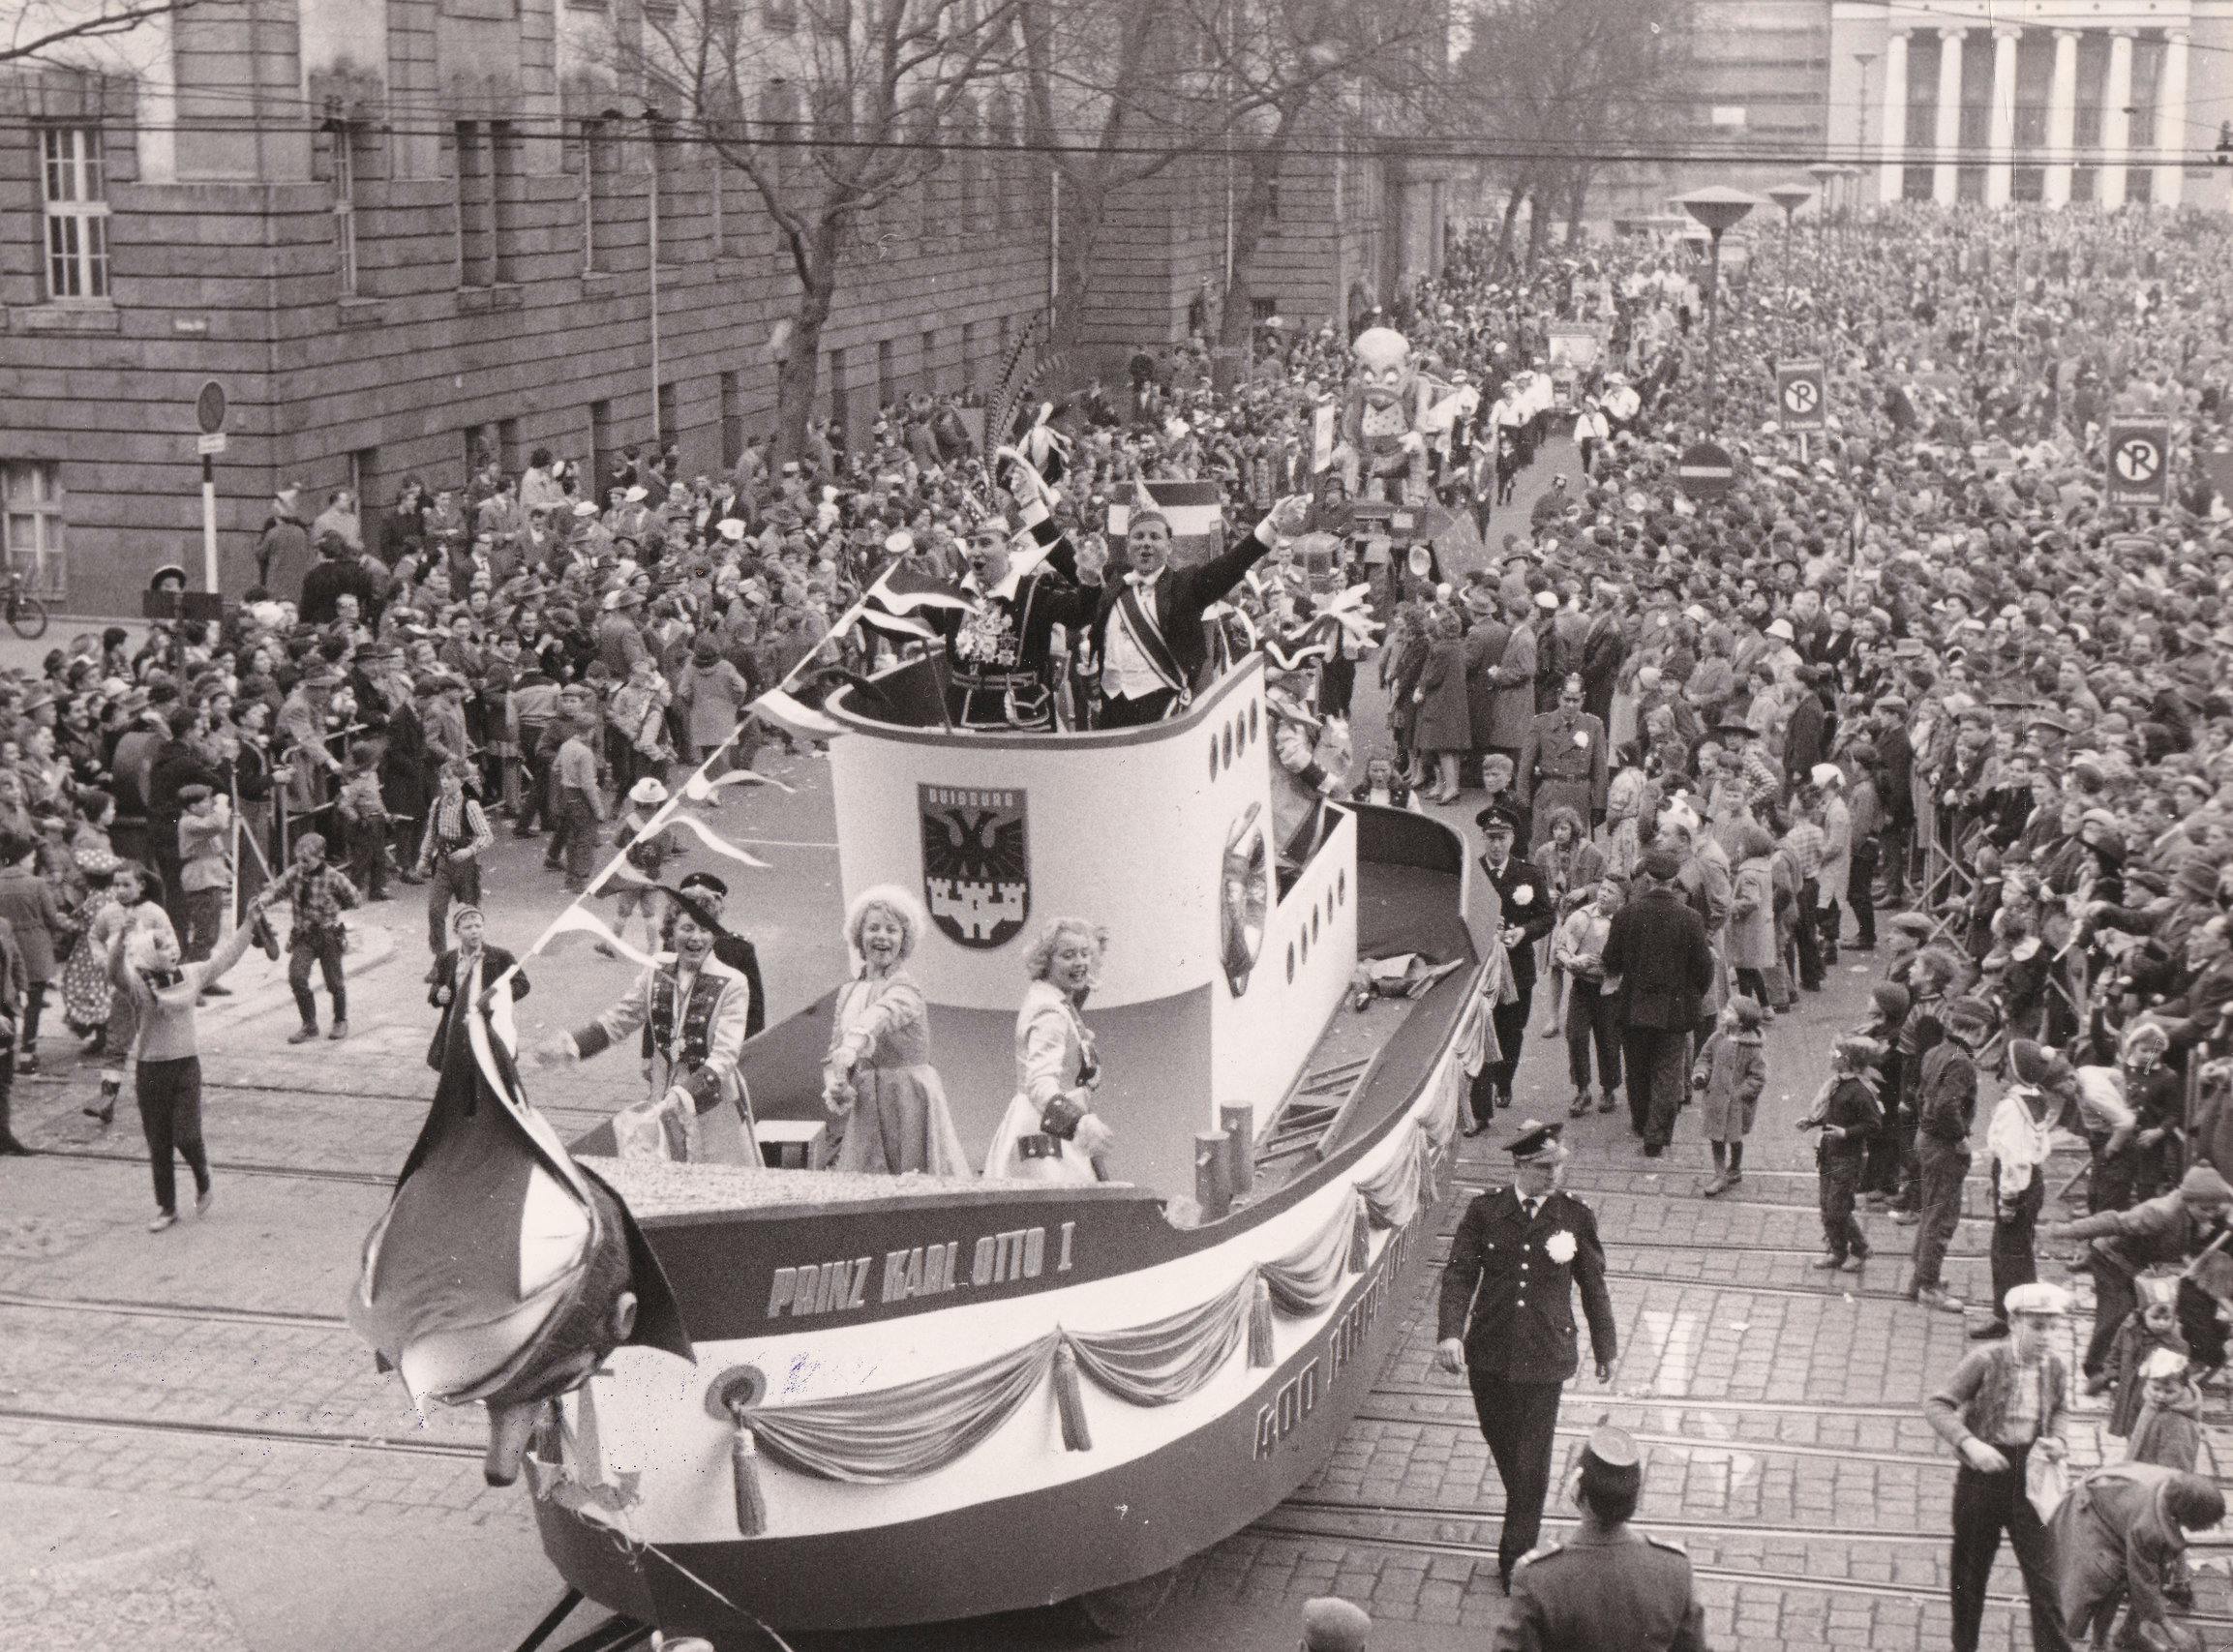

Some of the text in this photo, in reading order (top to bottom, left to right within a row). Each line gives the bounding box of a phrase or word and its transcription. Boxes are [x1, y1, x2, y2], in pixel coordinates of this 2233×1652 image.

[929, 787, 1013, 807] DUISBURG
[768, 1221, 1075, 1317] PRINZ KARL OTTO I
